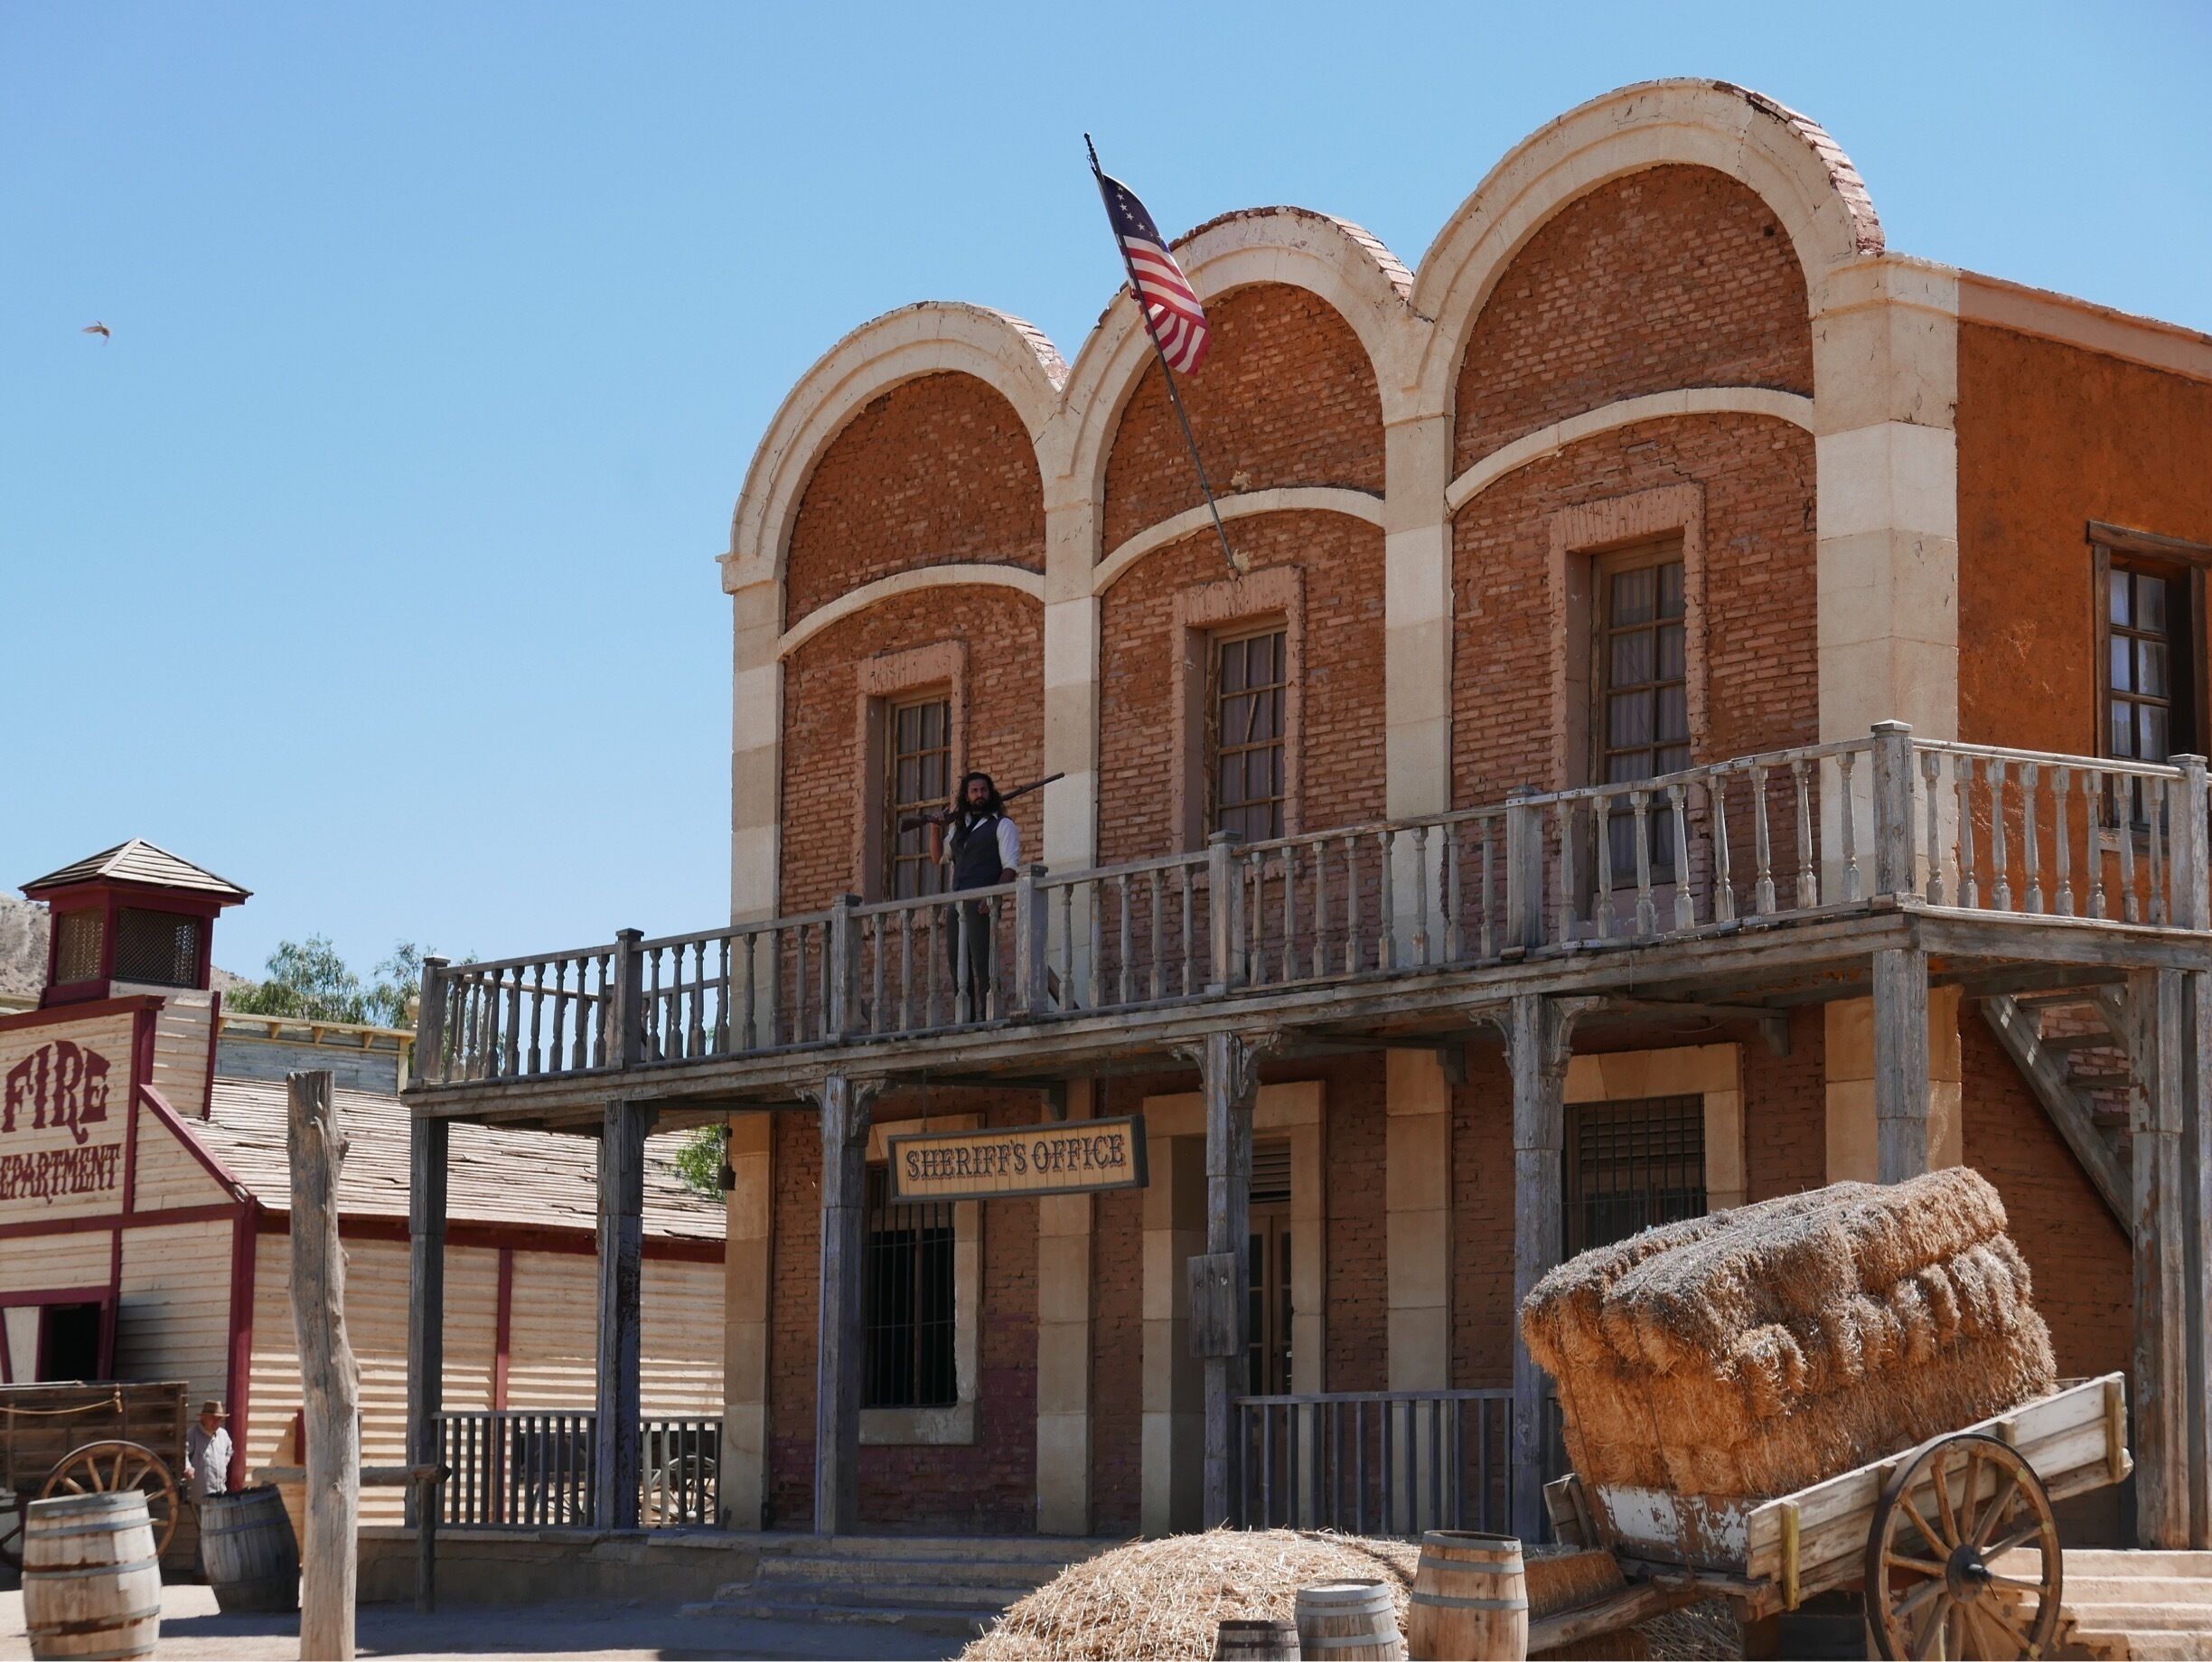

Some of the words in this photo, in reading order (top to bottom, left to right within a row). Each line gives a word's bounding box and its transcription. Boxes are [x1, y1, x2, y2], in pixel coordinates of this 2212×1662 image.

[2, 1040, 111, 1145] FIRE
[0, 1143, 121, 1205] EPARTMENT
[906, 1139, 1027, 1180] SHERIFF'S
[1031, 1134, 1126, 1172] OFFICE
